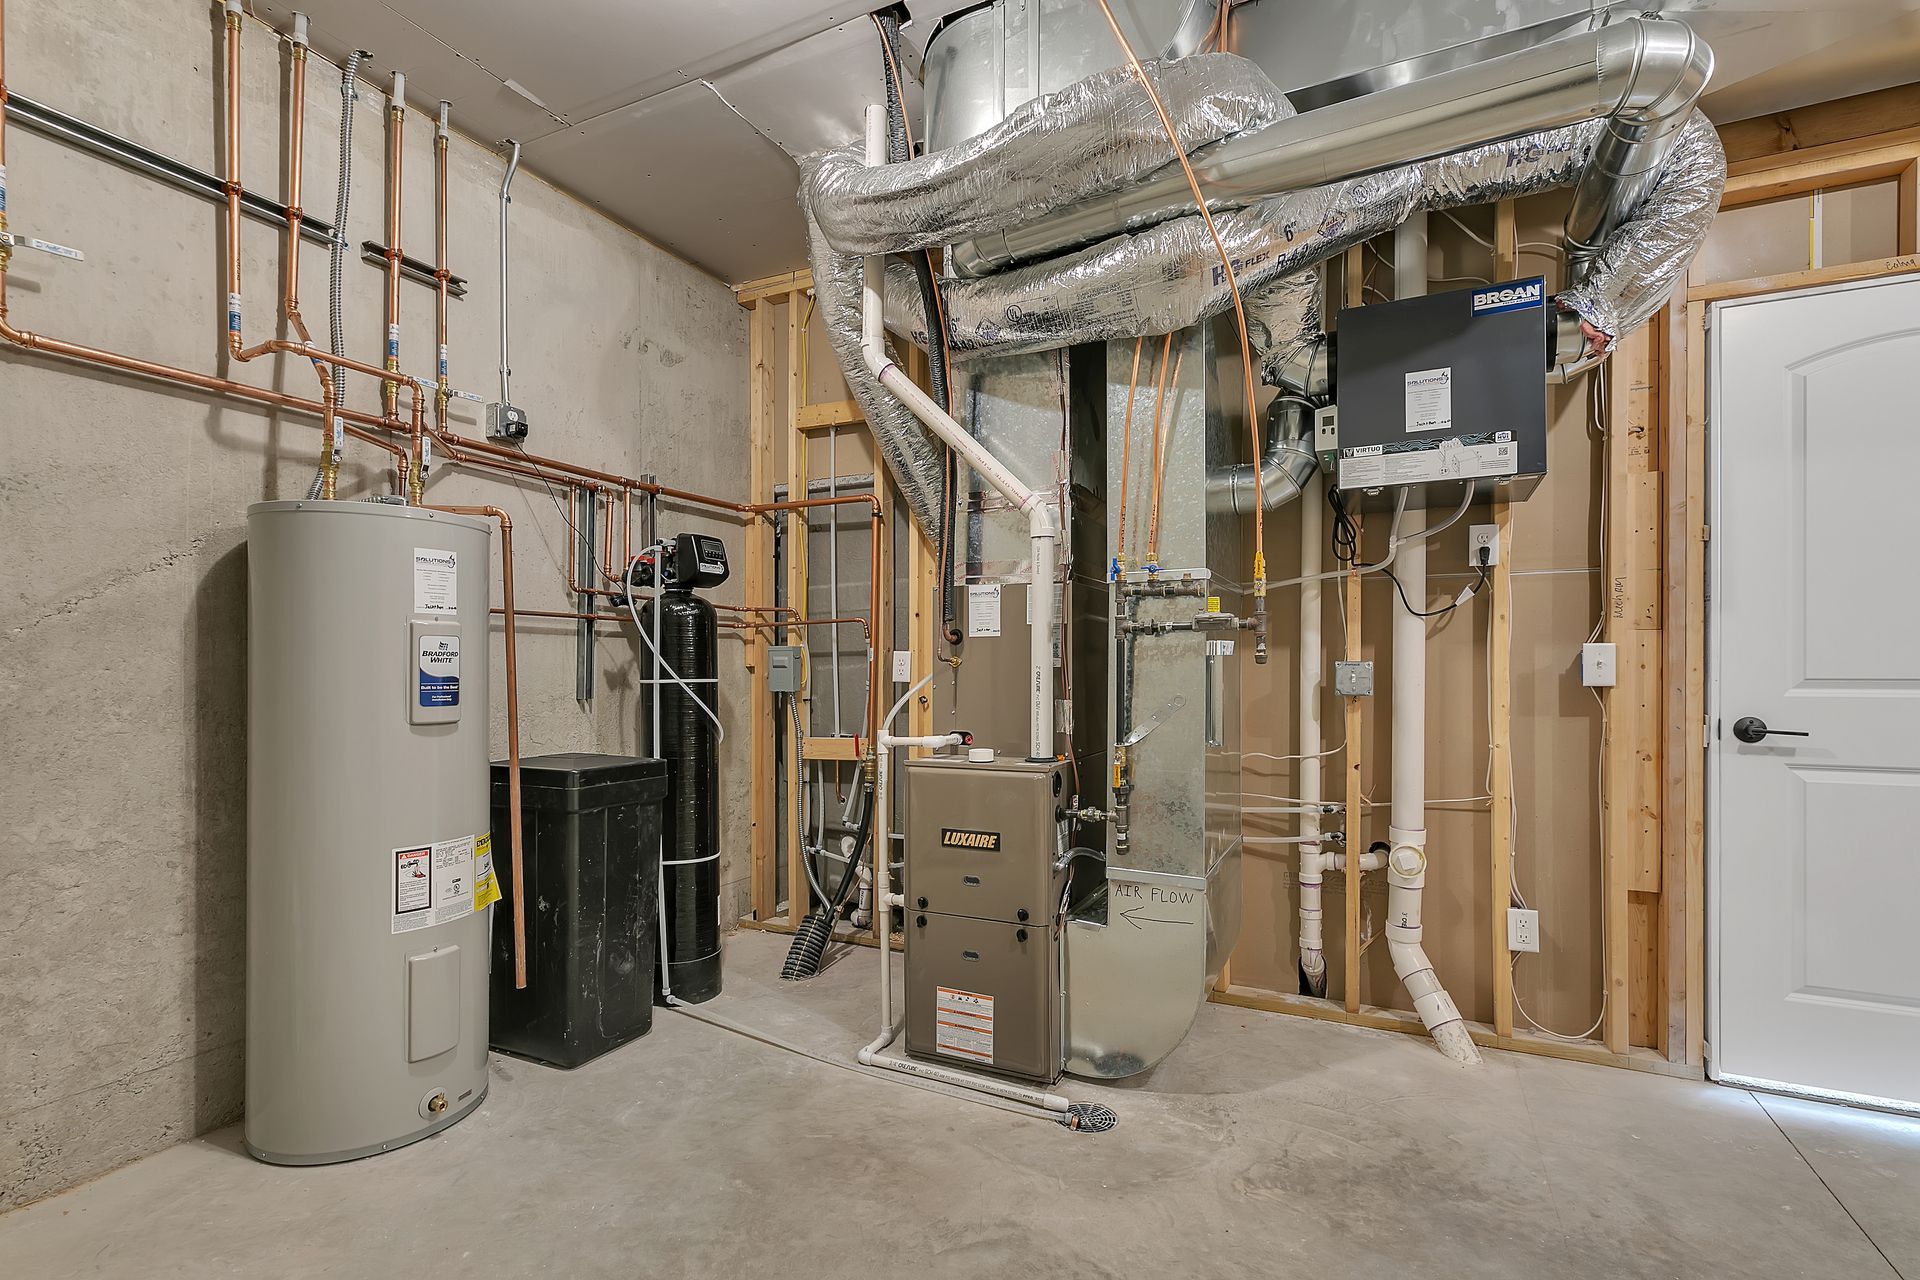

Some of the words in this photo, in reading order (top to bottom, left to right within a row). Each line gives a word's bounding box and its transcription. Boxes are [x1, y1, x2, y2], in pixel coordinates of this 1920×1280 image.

[1245, 251, 1270, 268] FLEX
[1474, 284, 1540, 306] BROAN
[1407, 376, 1443, 386] SOLUTIONS
[1355, 445, 1381, 454] VIRTUO
[416, 556, 451, 564] SOLUTIONS
[944, 831, 998, 849] LUXAIRE
[1115, 884, 1143, 899] AIR
[1151, 887, 1194, 904] FLOW
